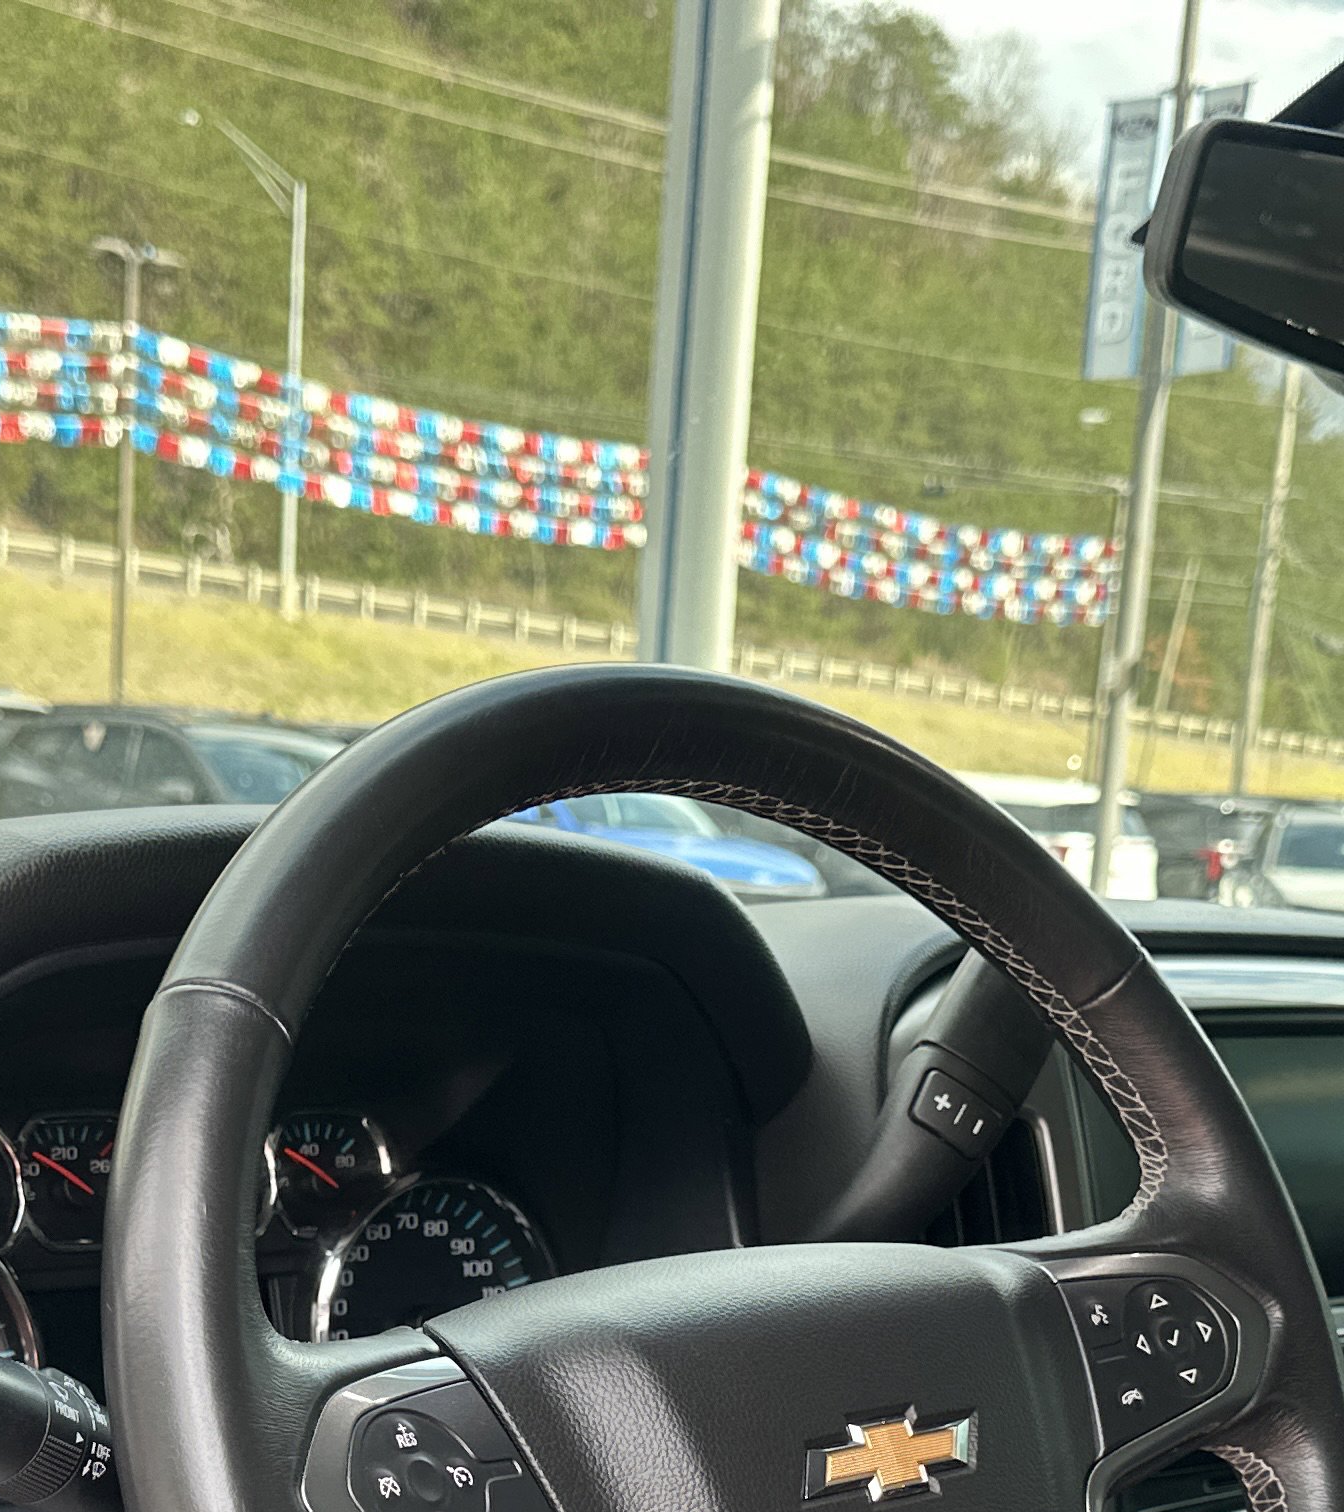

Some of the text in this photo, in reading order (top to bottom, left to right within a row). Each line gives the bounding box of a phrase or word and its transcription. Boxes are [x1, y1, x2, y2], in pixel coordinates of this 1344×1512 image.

[51, 1146, 78, 1160] 210
[90, 1160, 111, 1174] 26
[395, 1212, 419, 1230] 70
[423, 1220, 449, 1237] 80
[366, 1223, 391, 1241] 60
[450, 1238, 475, 1256] 90
[462, 1260, 493, 1278] 100
[395, 1432, 418, 1449] RES
[96, 1443, 111, 1461] OFF
